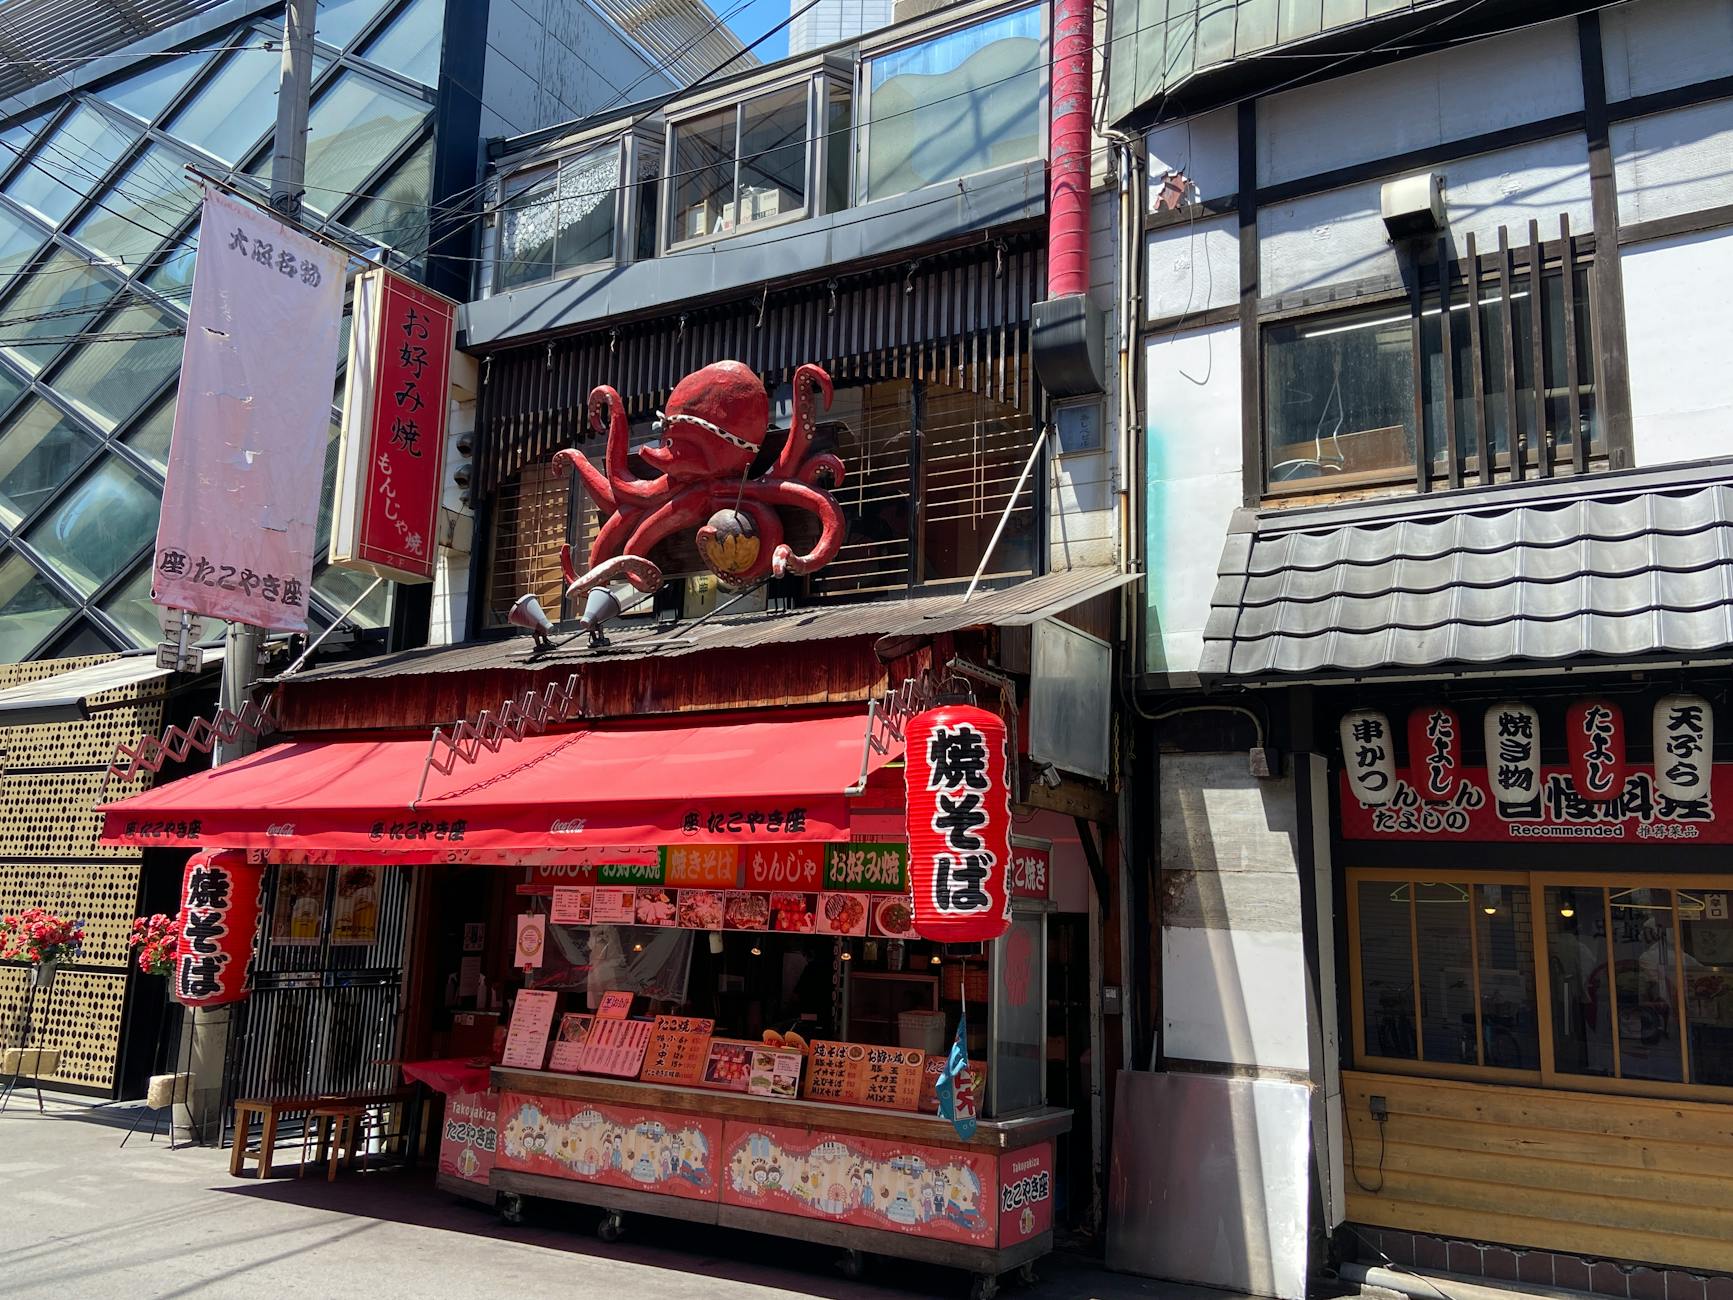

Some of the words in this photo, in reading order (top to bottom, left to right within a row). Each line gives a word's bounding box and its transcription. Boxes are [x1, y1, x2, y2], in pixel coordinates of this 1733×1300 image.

[228, 227, 322, 288] 大阪名物
[391, 307, 431, 458] お好み焼
[378, 452, 423, 556] もんじゃ焼
[193, 556, 303, 607] たこやき座
[1352, 719, 1388, 791] 串かつ
[1427, 711, 1454, 794] たよし
[1498, 711, 1534, 792] 焼き物
[1584, 705, 1615, 793] たよし
[1666, 706, 1704, 787] 天ぷら
[389, 819, 468, 841] たこやき座
[706, 808, 807, 834] たこやき座
[928, 724, 996, 912] 焼そば
[1373, 810, 1469, 832] たよしの
[1510, 825, 1624, 837] Recommended
[671, 847, 735, 881] 焼きそば
[752, 849, 817, 883] もんじゃ
[830, 850, 900, 885] お好み焼
[1012, 856, 1046, 891] こ焼き
[181, 864, 234, 998] 焼そば
[813, 1043, 848, 1060] 焼そば
[446, 1119, 497, 1152] たこやき座
[1013, 1157, 1040, 1173] Takoyakiza
[1001, 1170, 1050, 1213] たこやき座
